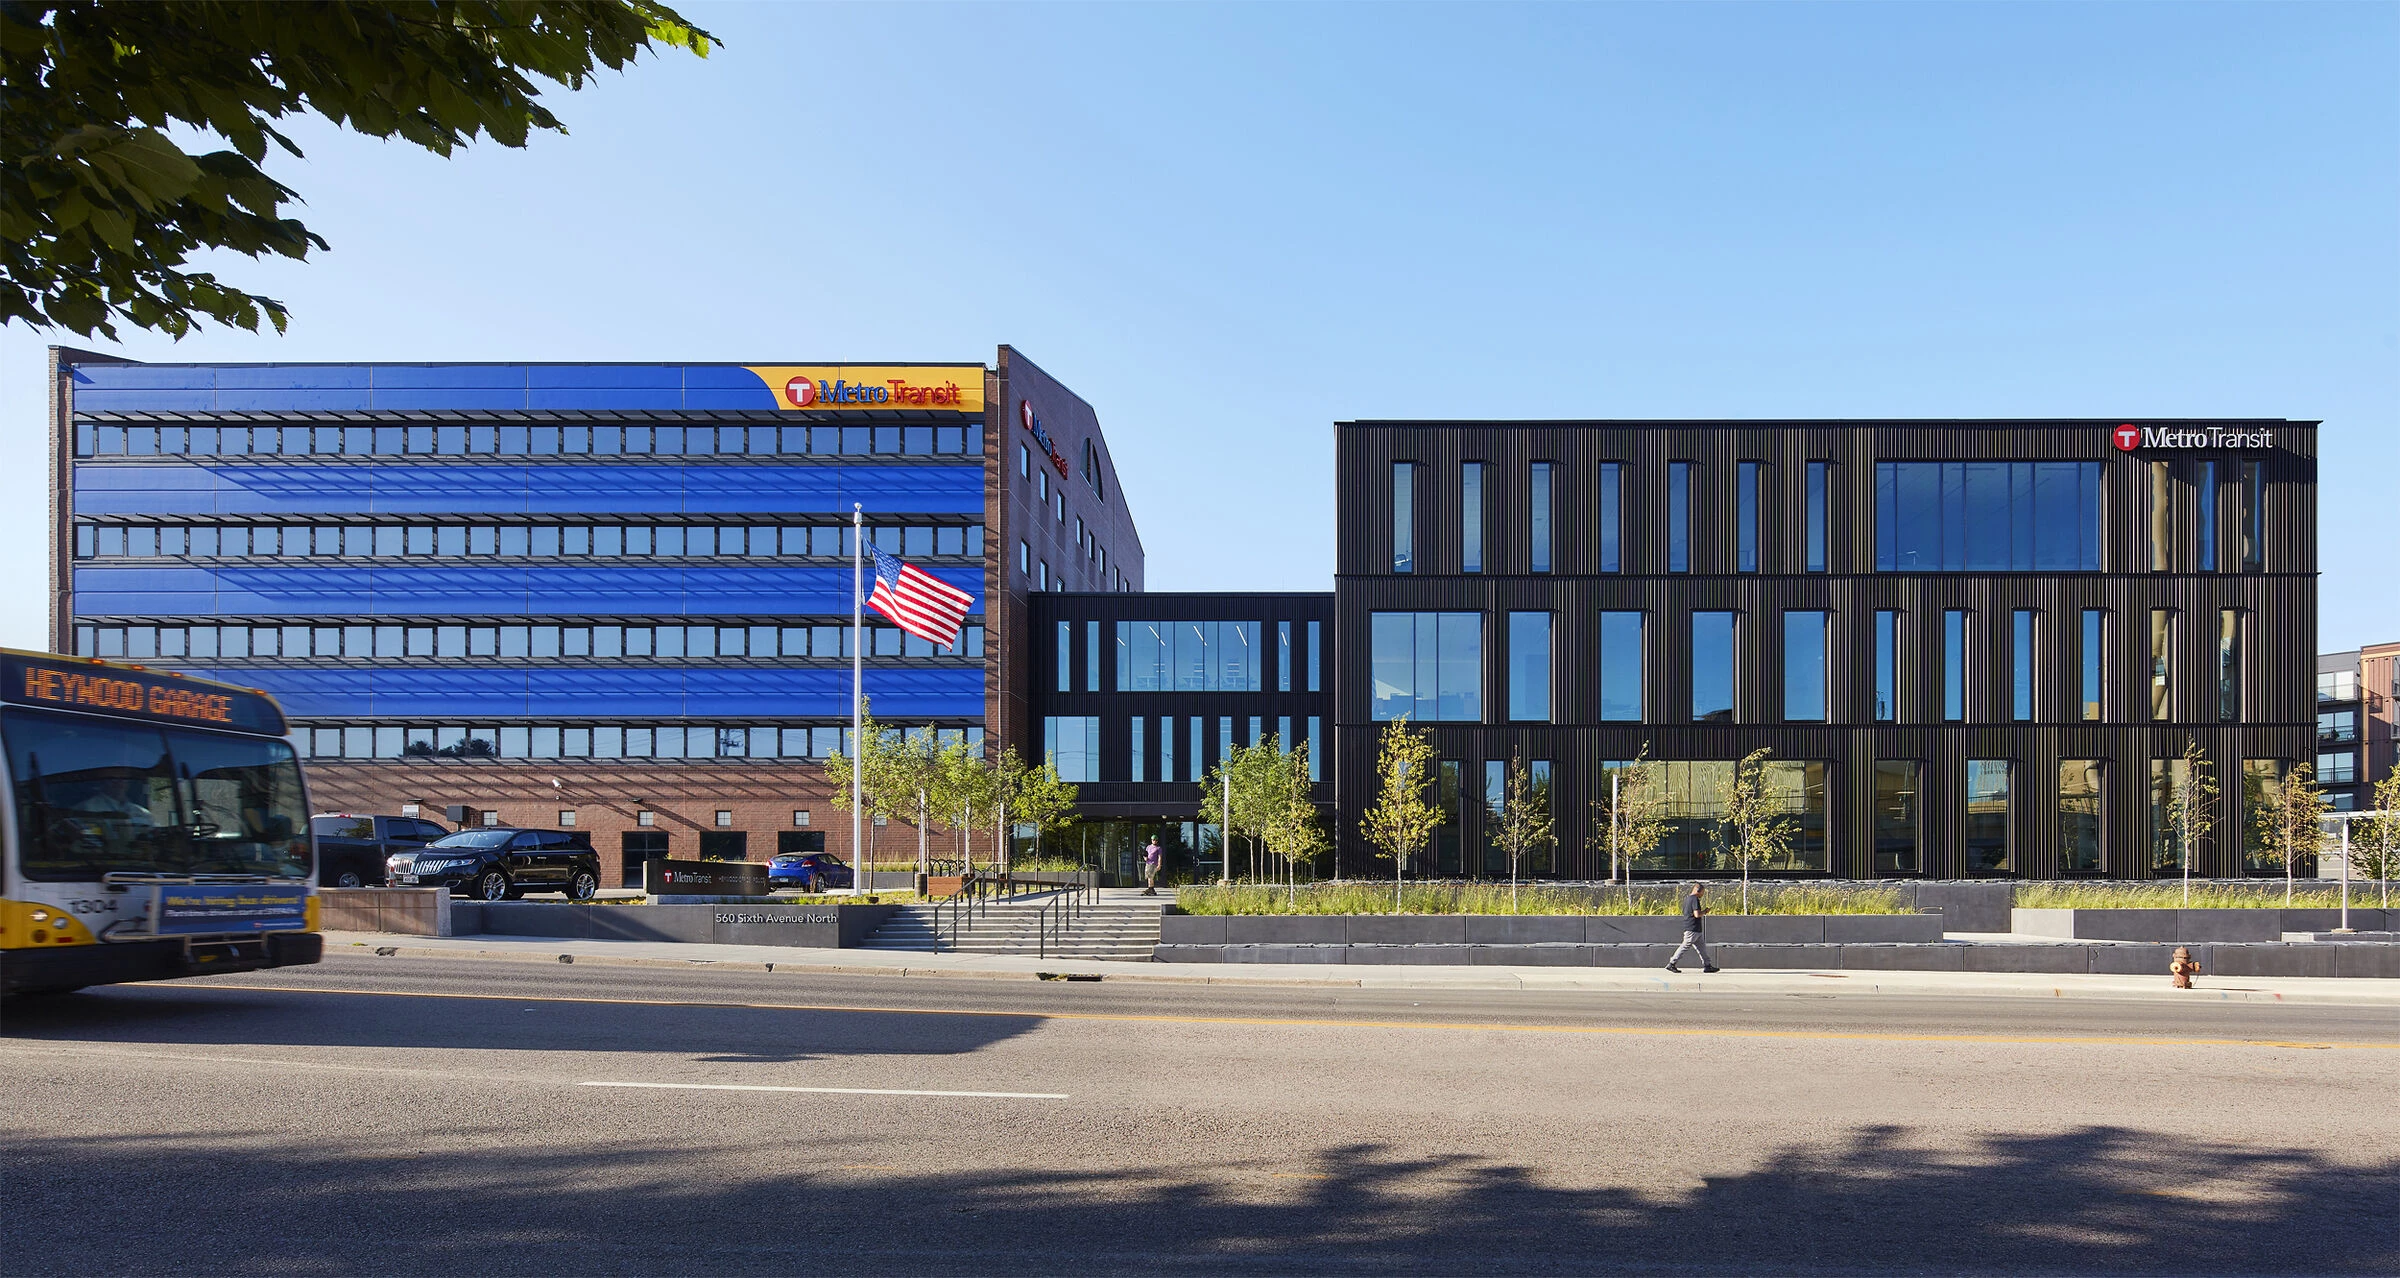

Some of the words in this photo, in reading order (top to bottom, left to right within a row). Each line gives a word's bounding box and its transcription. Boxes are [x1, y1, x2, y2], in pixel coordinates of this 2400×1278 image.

[25, 667, 144, 711] HEYWOOD
[149, 685, 233, 723] GARAGE
[716, 914, 735, 924] 560
[738, 913, 763, 924] Sixth
[766, 914, 804, 924] Avenue
[807, 914, 837, 924] North
